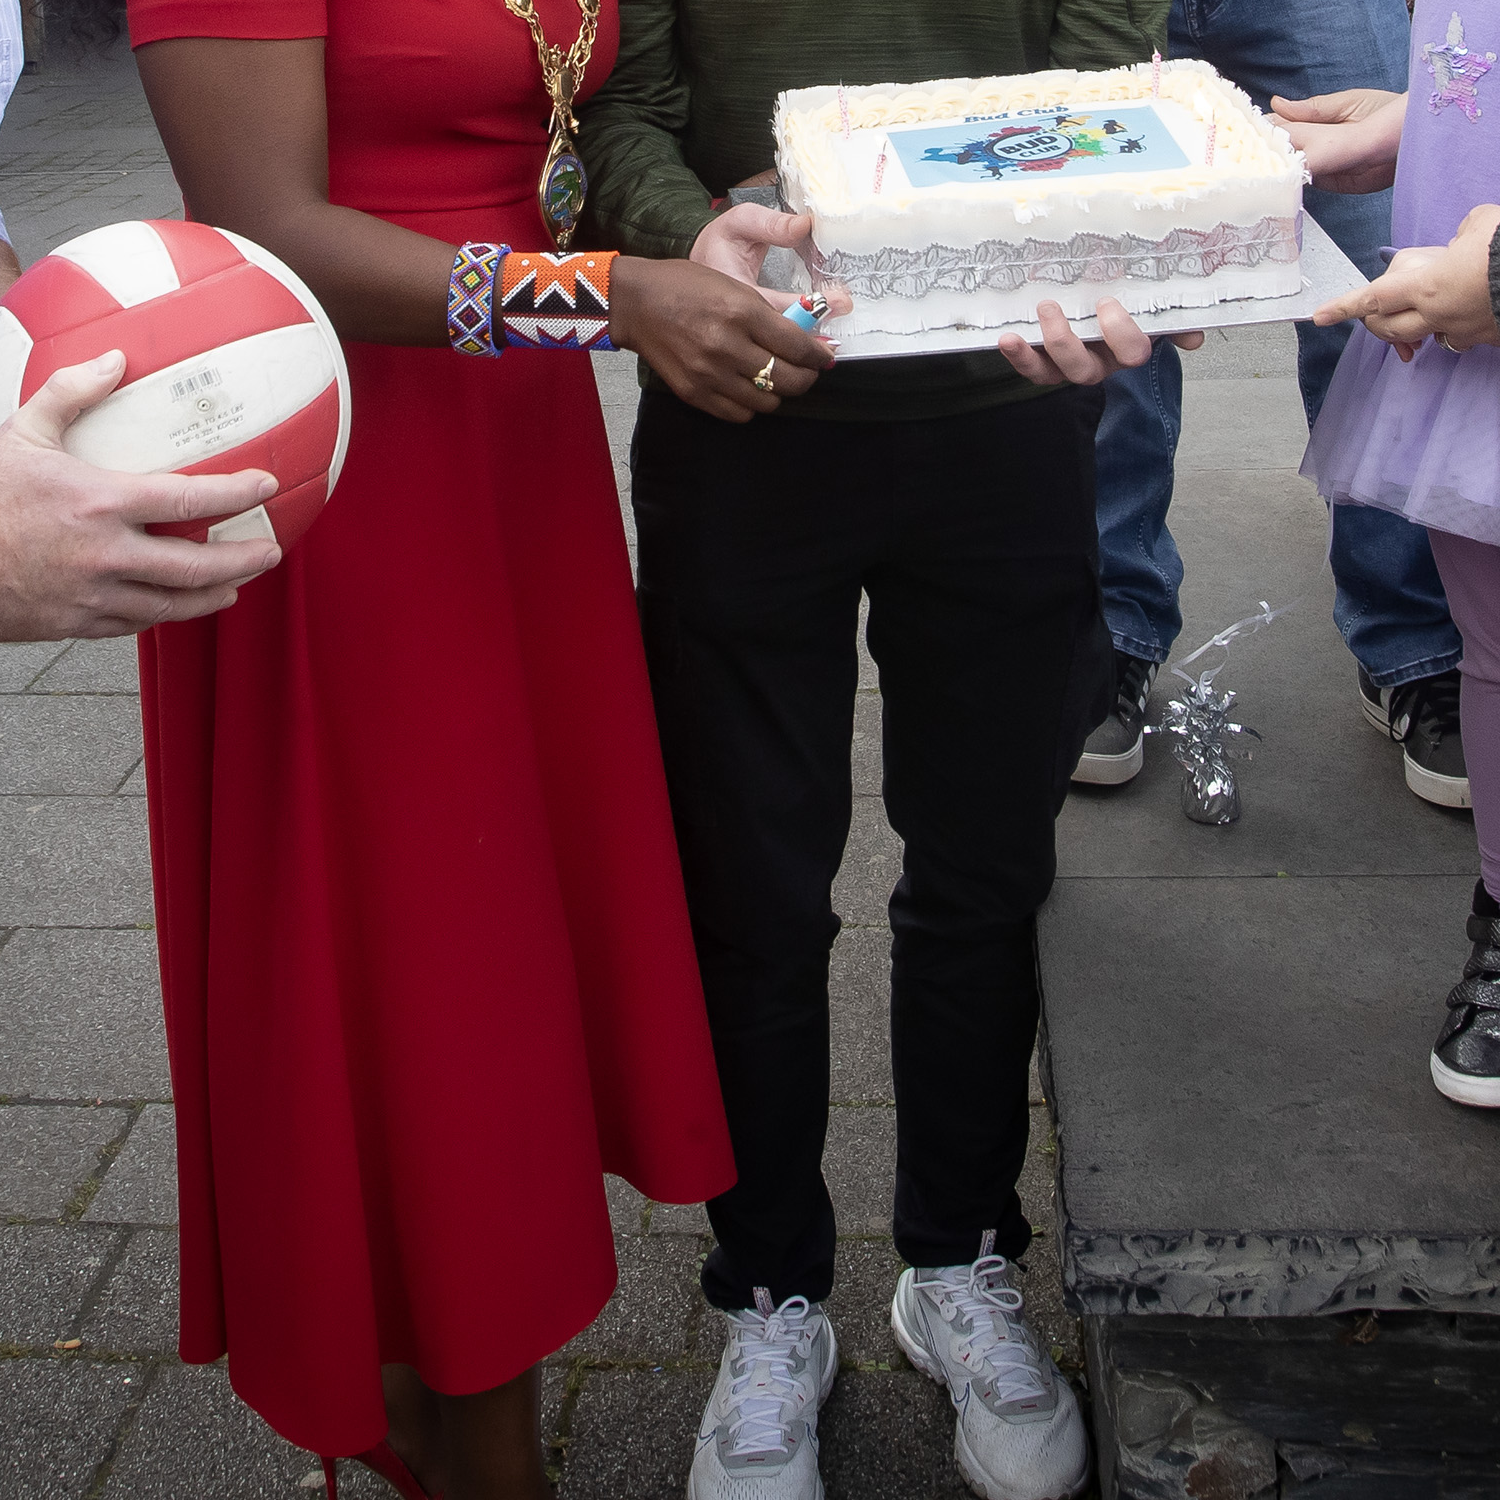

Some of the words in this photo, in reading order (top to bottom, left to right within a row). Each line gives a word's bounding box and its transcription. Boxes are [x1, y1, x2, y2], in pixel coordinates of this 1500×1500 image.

[964, 112, 1010, 123] Bud
[1017, 106, 1069, 116] Club
[998, 135, 1058, 155] BUD
[1019, 145, 1061, 158] CLUB
